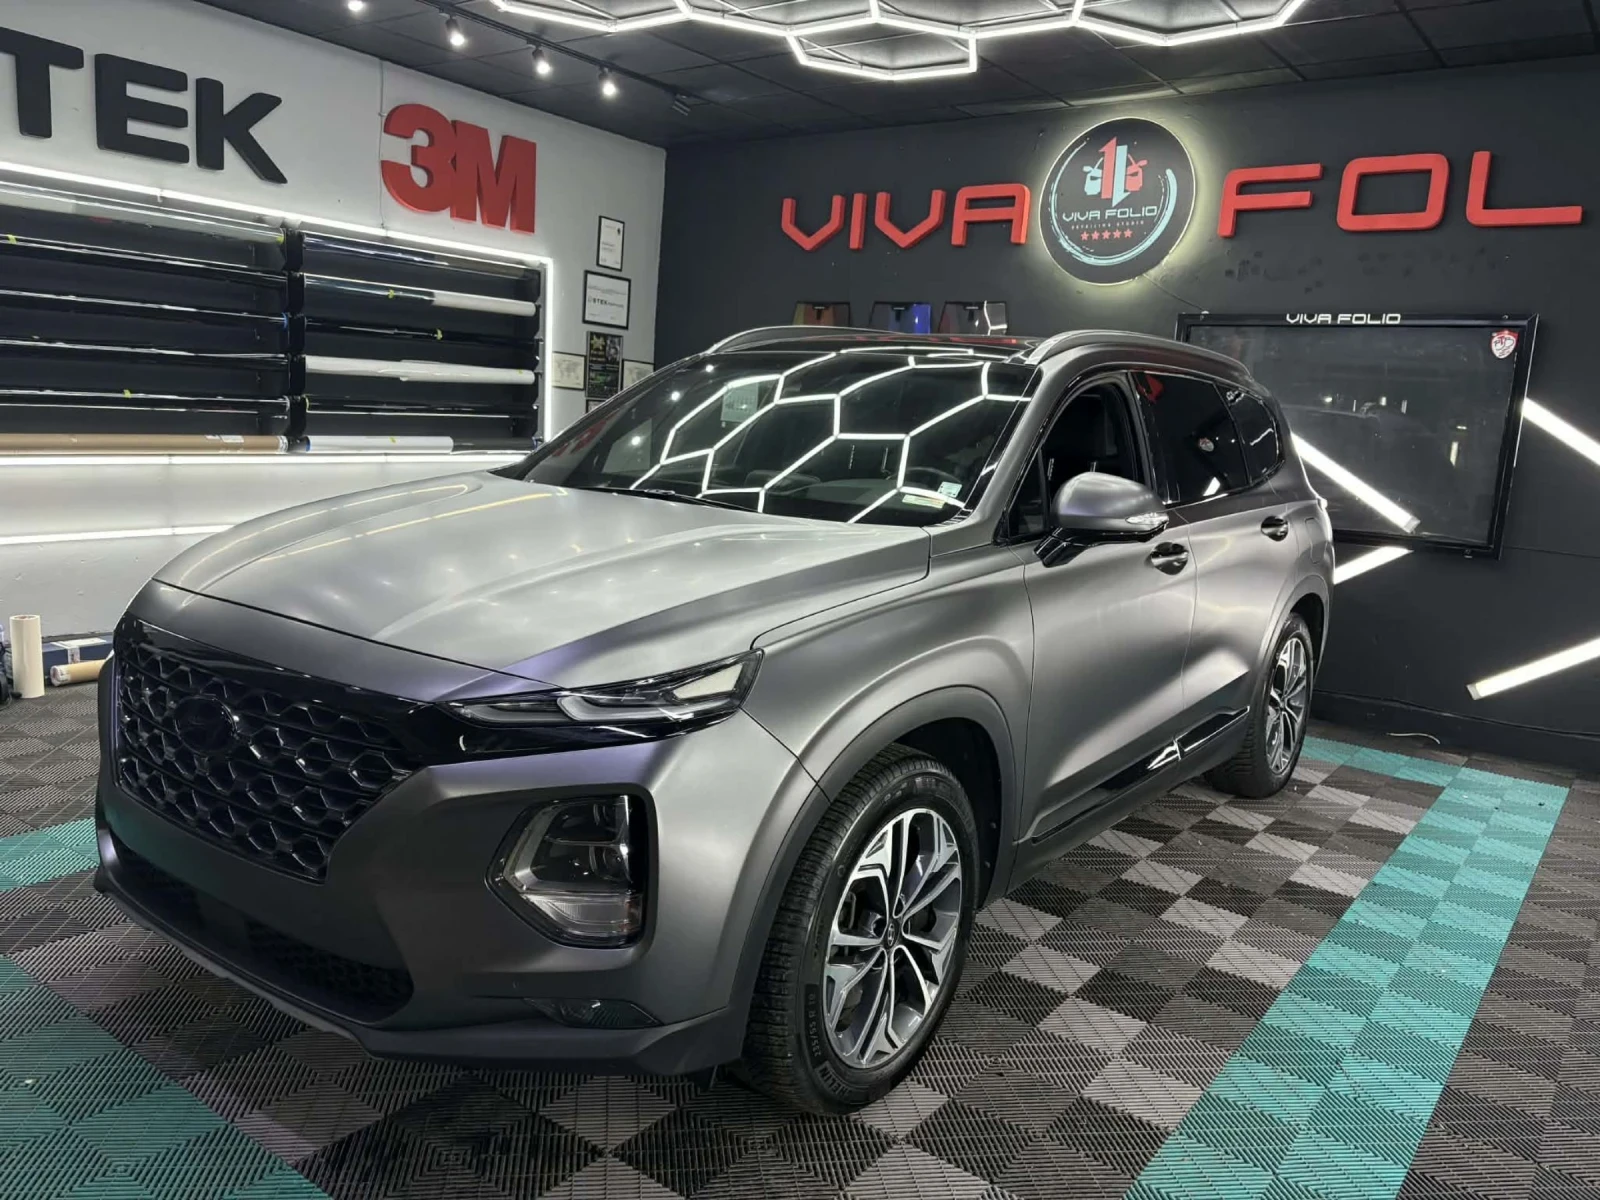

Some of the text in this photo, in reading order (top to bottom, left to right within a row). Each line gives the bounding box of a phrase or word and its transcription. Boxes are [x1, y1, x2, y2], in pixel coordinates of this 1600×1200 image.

[0, 27, 287, 184] TEK
[381, 103, 537, 234] 3M
[781, 151, 1583, 250] VIVA FOL
[1062, 206, 1158, 222] VIVA FOLIO
[1285, 313, 1401, 325] VIVA FOLIO
